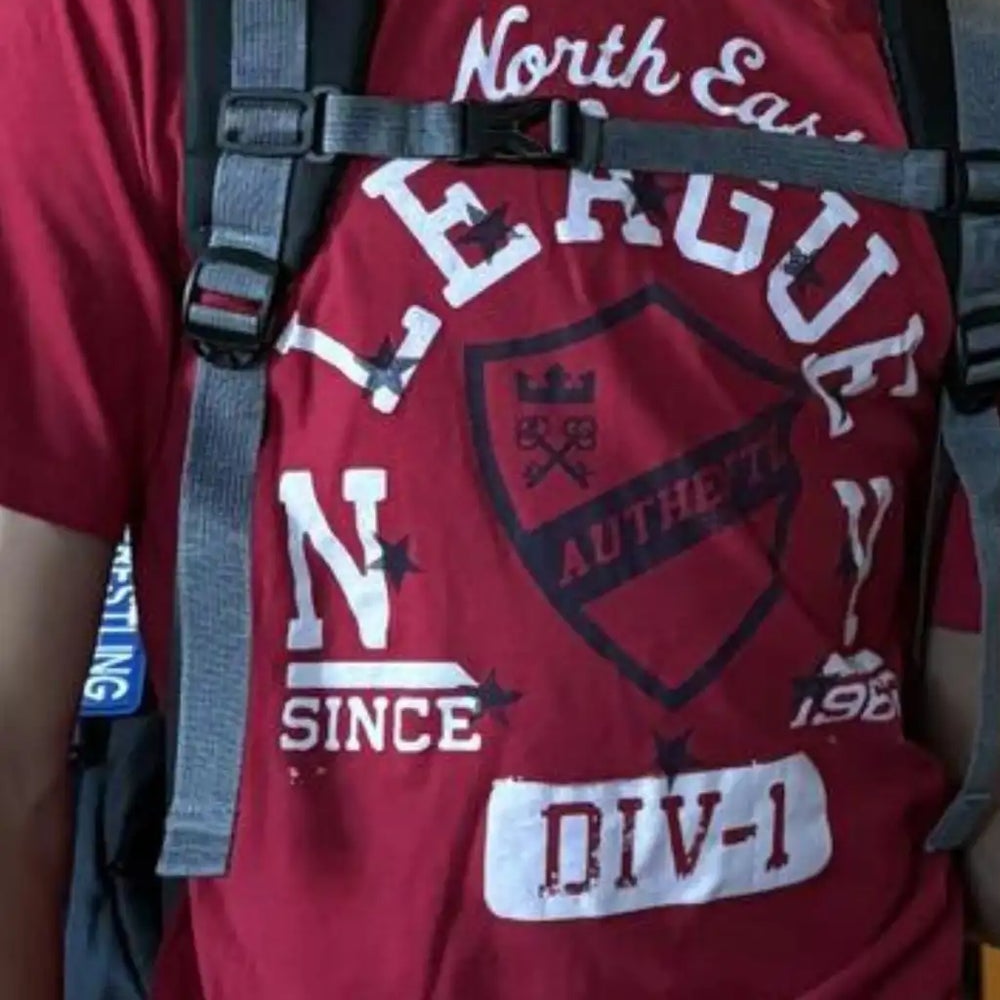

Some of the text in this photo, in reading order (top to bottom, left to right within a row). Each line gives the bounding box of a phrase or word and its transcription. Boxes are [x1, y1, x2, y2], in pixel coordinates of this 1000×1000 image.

[452, 5, 680, 103] North
[276, 101, 924, 437] LEAGUE
[82, 523, 139, 702] RESTLING
[279, 468, 389, 650] N
[279, 695, 482, 752] SINCE
[538, 781, 790, 898] DIV-1
